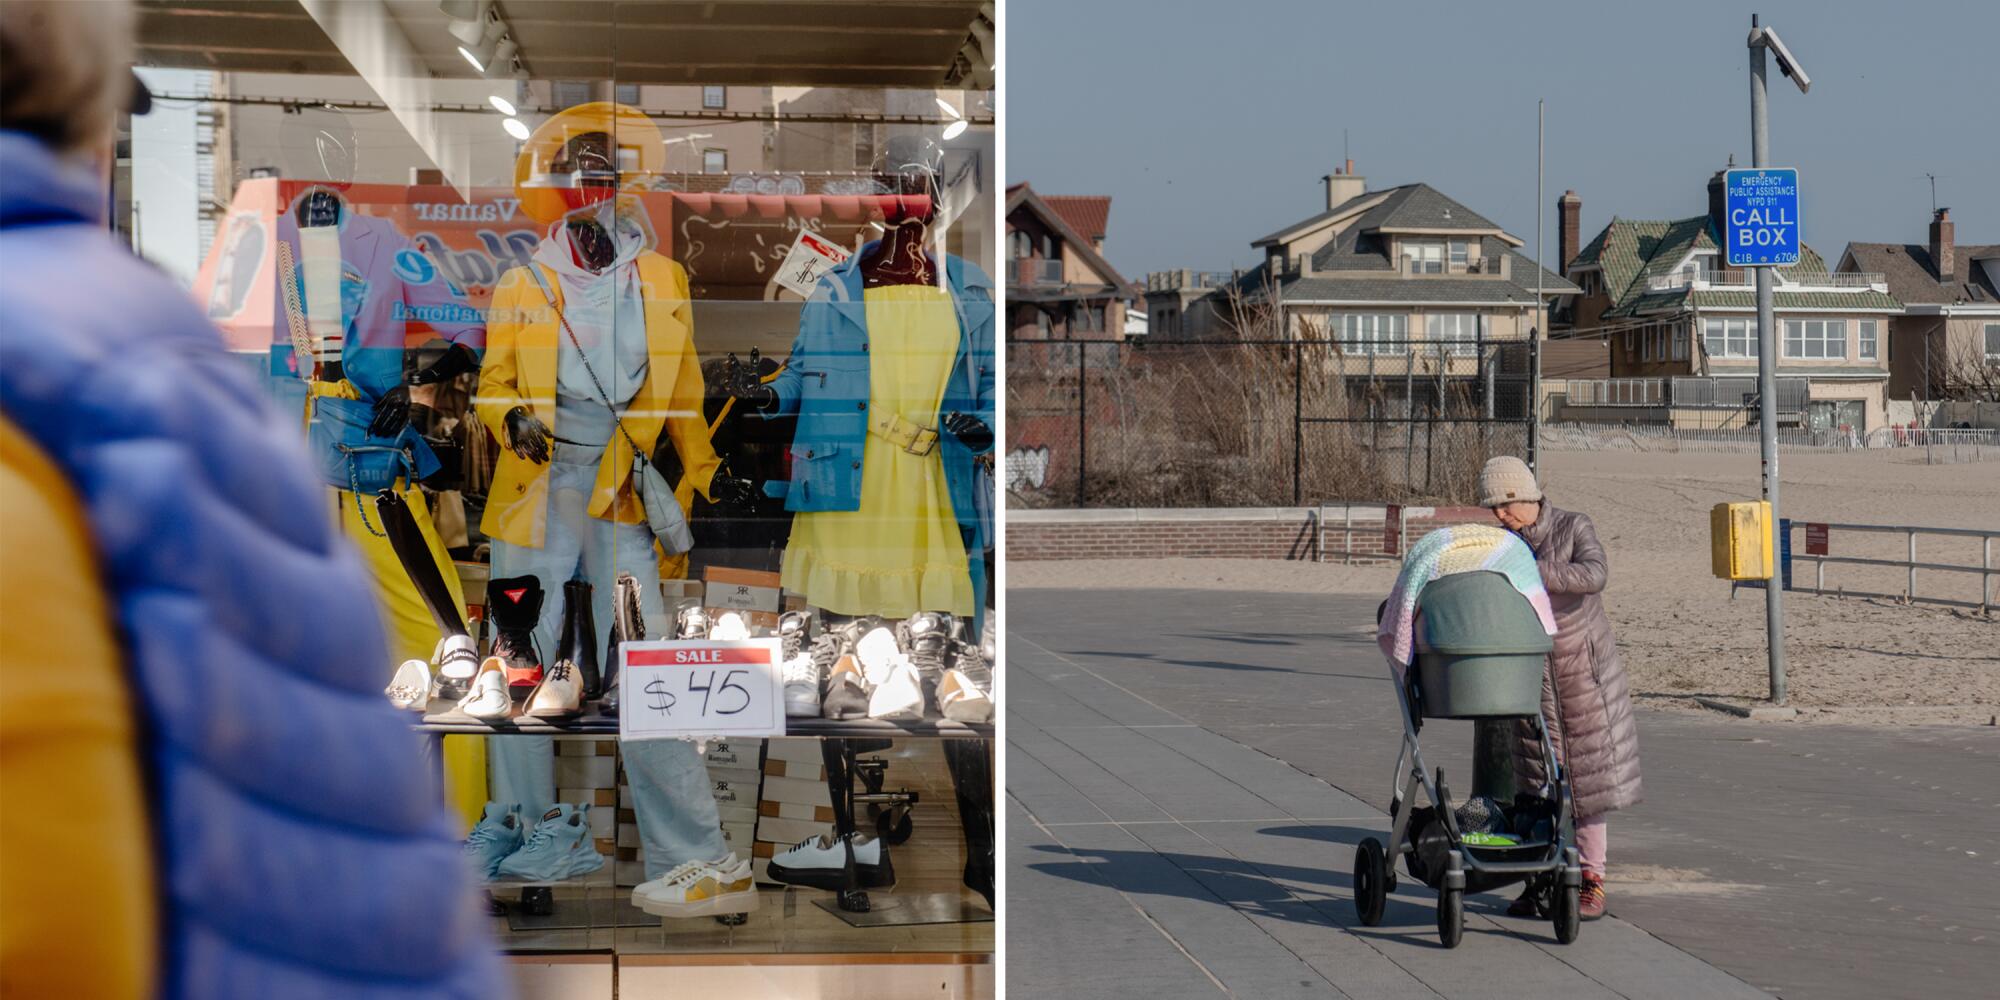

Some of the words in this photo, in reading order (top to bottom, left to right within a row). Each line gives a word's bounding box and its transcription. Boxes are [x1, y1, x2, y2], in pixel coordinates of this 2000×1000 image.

[1742, 177, 1782, 186] EMERGENCY
[1730, 187, 1753, 196] PUBLIC
[1756, 186, 1795, 196] ASSISTANCE
[1747, 197, 1765, 206] NYPD
[1767, 197, 1777, 206] 911
[1732, 208, 1794, 226] CALL
[1740, 228, 1786, 246] BOX
[1734, 253, 1752, 262] CIB
[1774, 252, 1798, 262] 6706
[675, 650, 722, 663] SALE
